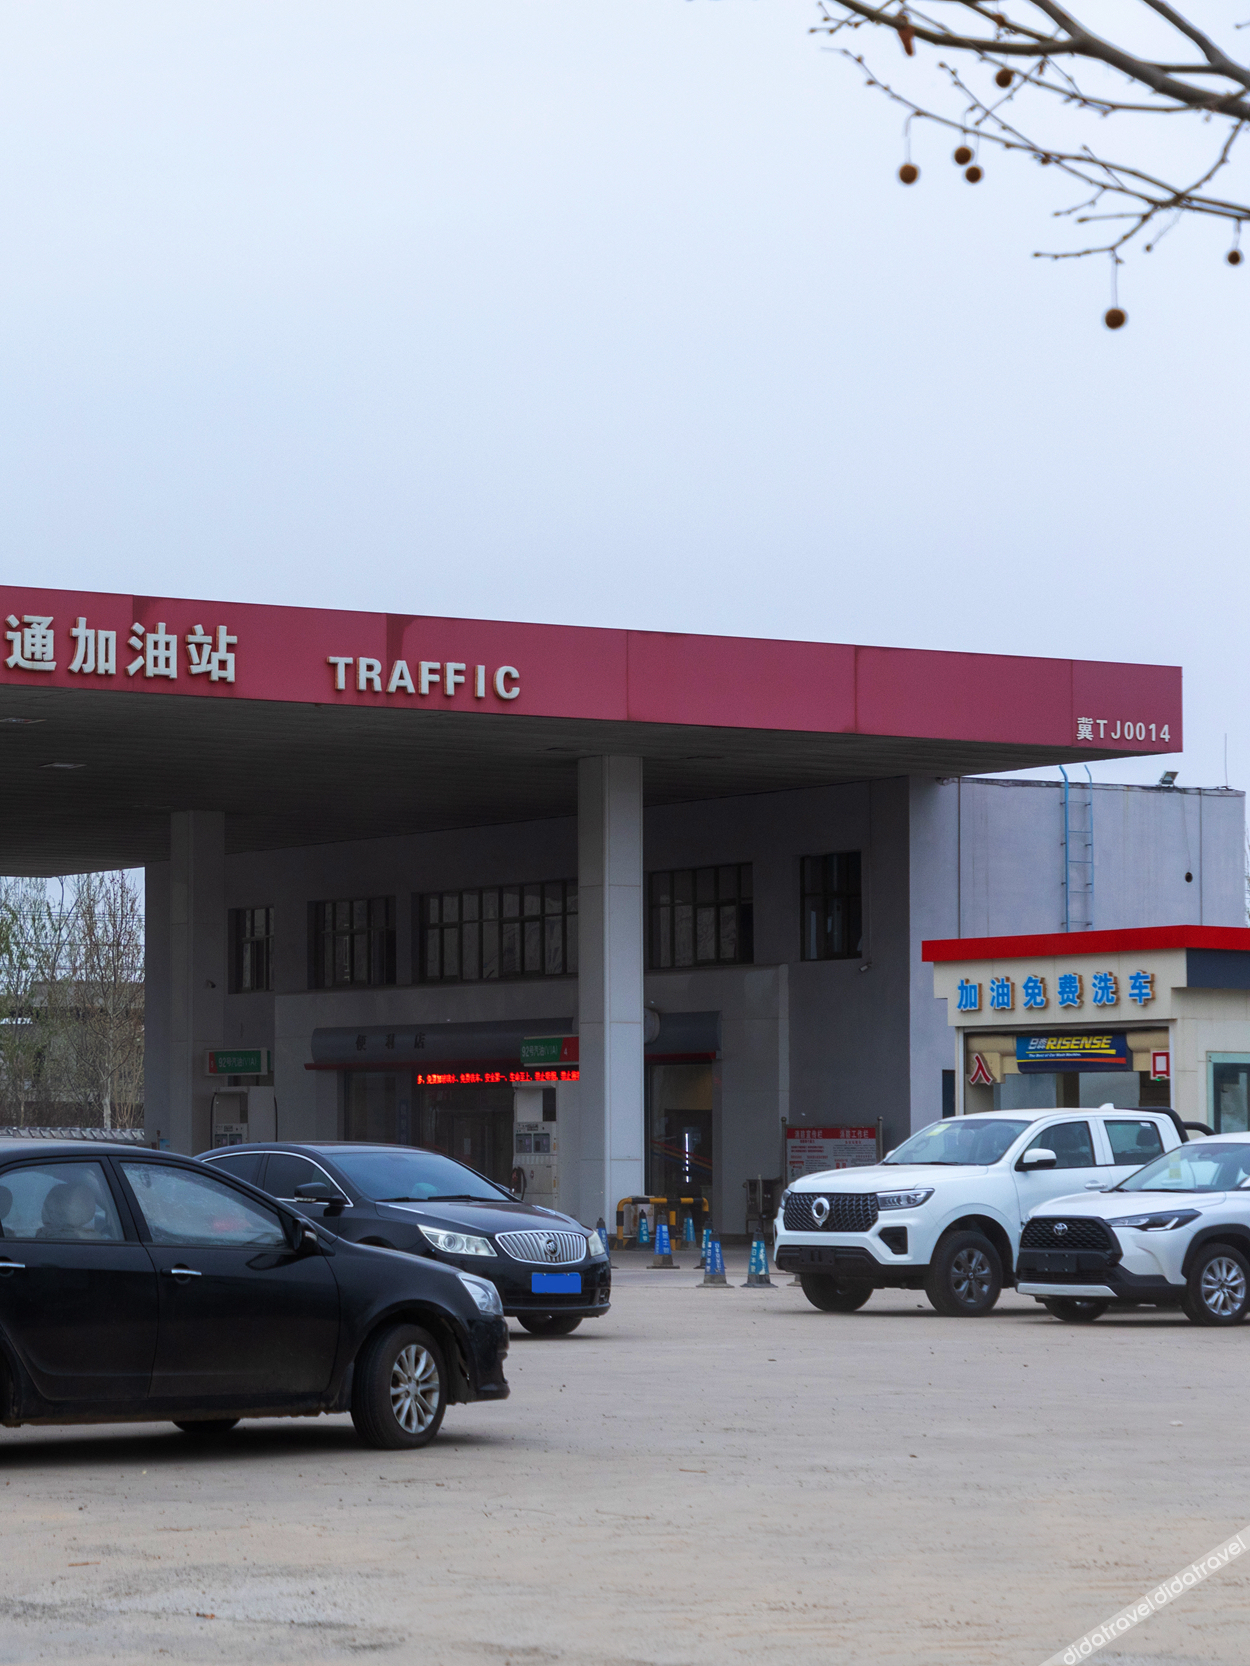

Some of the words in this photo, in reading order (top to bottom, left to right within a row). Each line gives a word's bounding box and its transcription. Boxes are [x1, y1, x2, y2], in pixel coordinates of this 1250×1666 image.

[327, 656, 521, 700] TRAFFIC
[1076, 717, 1171, 743] 冀TJ0014
[956, 969, 1156, 1012] 加油免费洗车
[563, 1047, 568, 1056] 4
[969, 1053, 993, 1086] 入
[1151, 1051, 1170, 1079] 口
